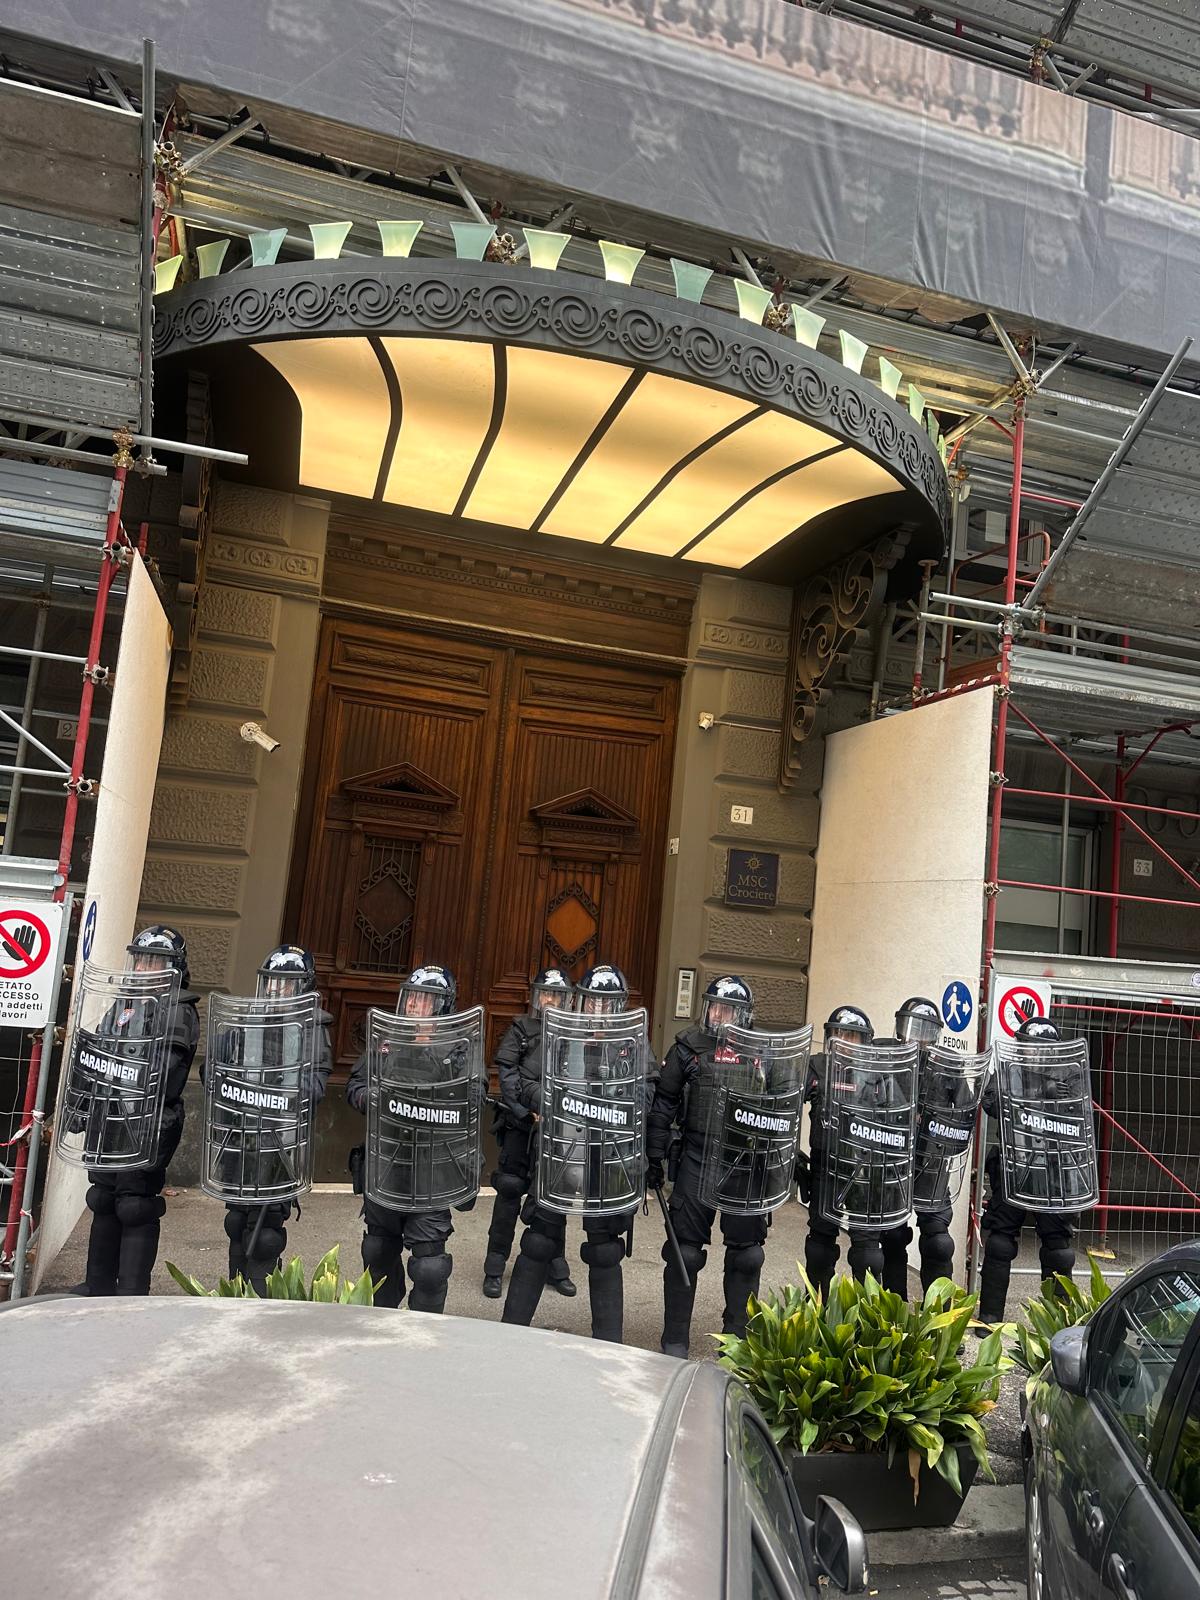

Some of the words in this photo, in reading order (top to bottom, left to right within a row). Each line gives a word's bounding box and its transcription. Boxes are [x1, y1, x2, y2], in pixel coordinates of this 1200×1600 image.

[733, 808, 748, 822] 31
[1135, 861, 1150, 873] 33
[738, 874, 768, 888] MSC
[728, 884, 775, 901] Crociere
[0, 991, 39, 1001] CESSO
[7, 1001, 43, 1011] addetti
[943, 1036, 969, 1051] PEDONI
[80, 1050, 139, 1081] CARABINIERI
[221, 1083, 289, 1111] CARABINIERI
[388, 1099, 460, 1124] CARABINIERI
[562, 1096, 627, 1125] CARABINIERI
[734, 1108, 791, 1132] CARABINIERI
[849, 1122, 906, 1148] CARABINIERI
[928, 1120, 970, 1141] CARABINIERI
[1020, 1112, 1080, 1137] CARABINIERI
